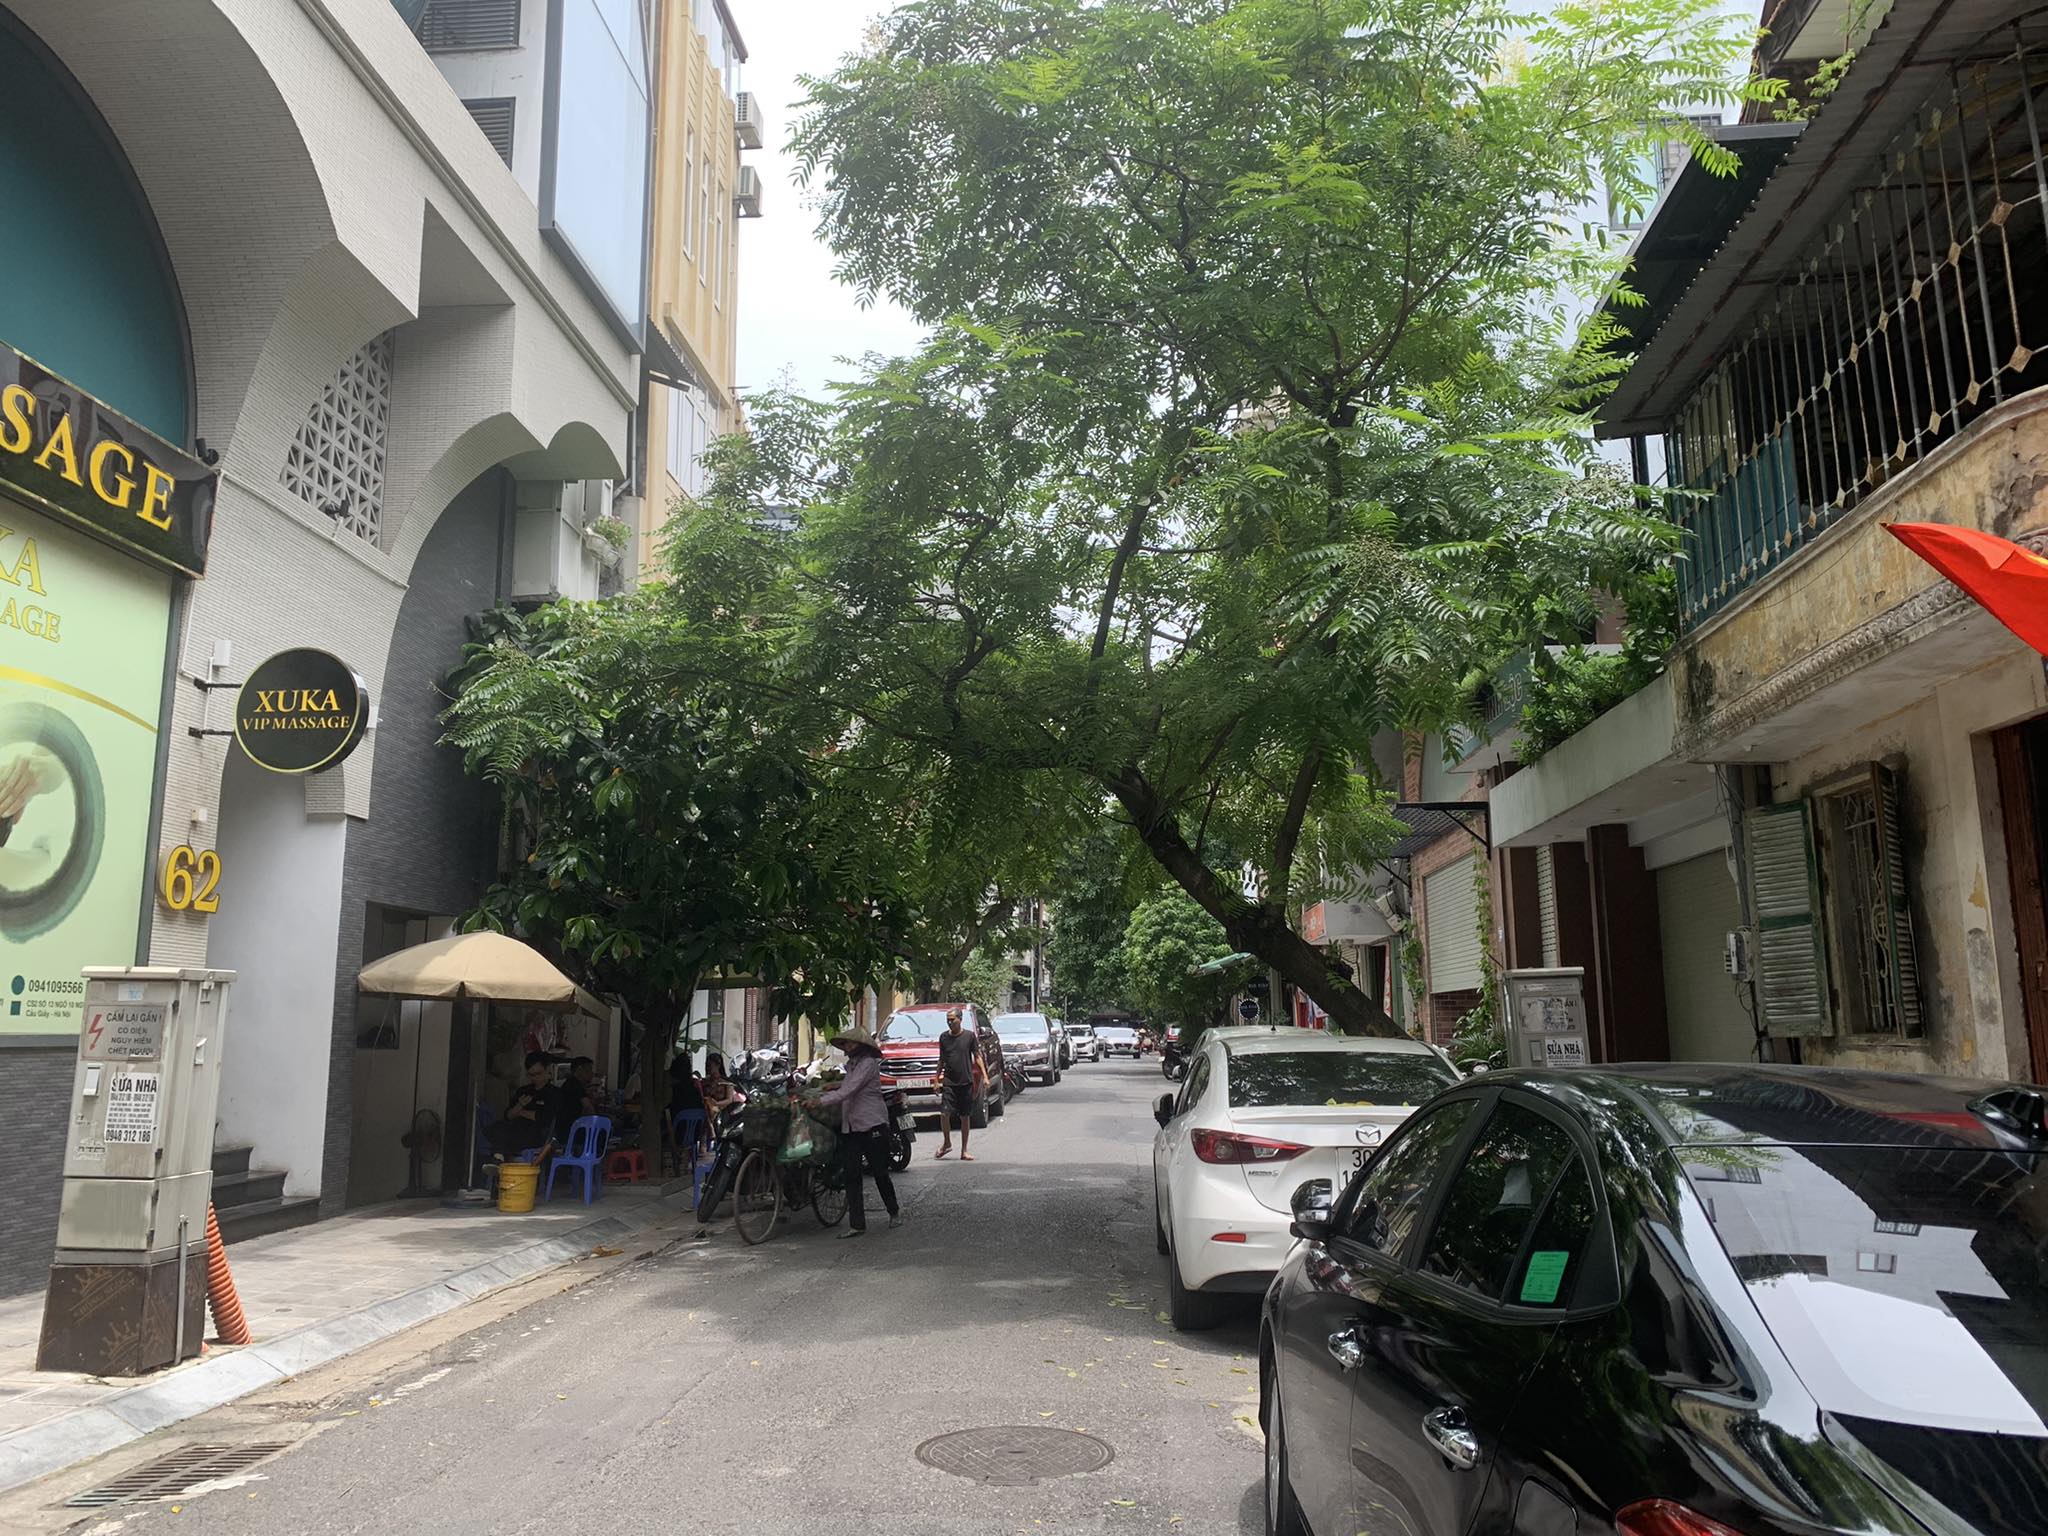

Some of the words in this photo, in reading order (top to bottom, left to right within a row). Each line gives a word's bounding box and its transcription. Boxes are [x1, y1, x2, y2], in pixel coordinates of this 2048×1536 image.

[254, 688, 341, 713] XUKA
[243, 717, 270, 731] VIP
[272, 716, 351, 730] MASSAGE
[165, 844, 221, 913] 62
[28, 979, 83, 993] 0941095566
[1547, 1040, 1563, 1054] SỬA
[1563, 1041, 1580, 1054] NHÀ
[135, 1076, 157, 1092] NHÀ
[123, 1130, 137, 1142] 312
